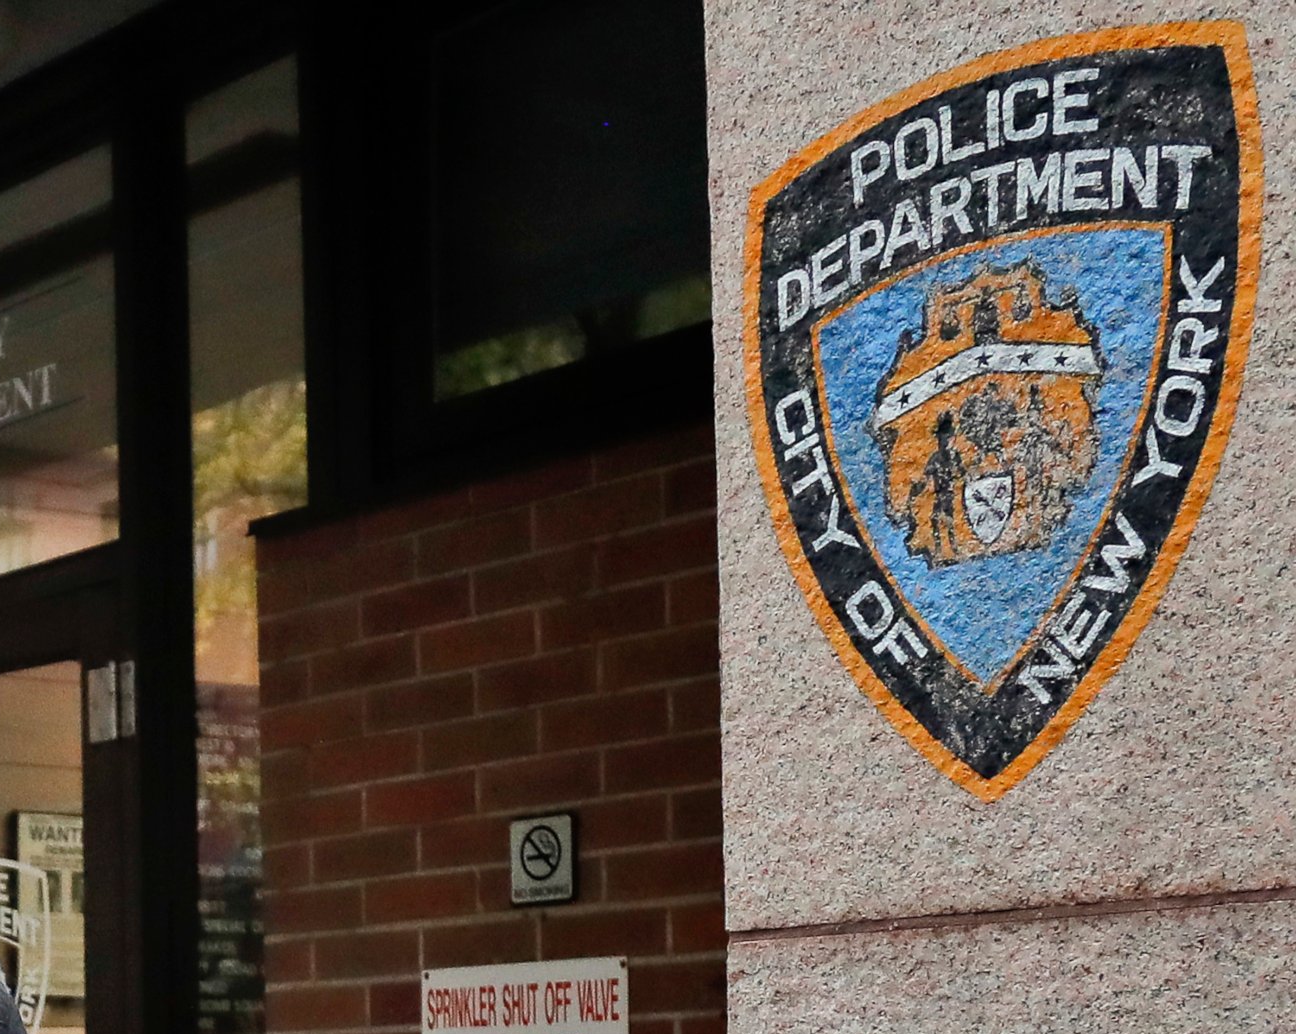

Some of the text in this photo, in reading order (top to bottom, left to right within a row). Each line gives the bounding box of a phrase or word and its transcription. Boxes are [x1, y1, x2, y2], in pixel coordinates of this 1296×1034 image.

[849, 67, 1101, 208] POLICE
[777, 144, 1212, 332] DEPARTMENT
[774, 389, 929, 665] CITY OF
[1017, 254, 1225, 703] NEW YORK
[427, 978, 620, 1030] SPRINKLER SHUT OFF VALVE
